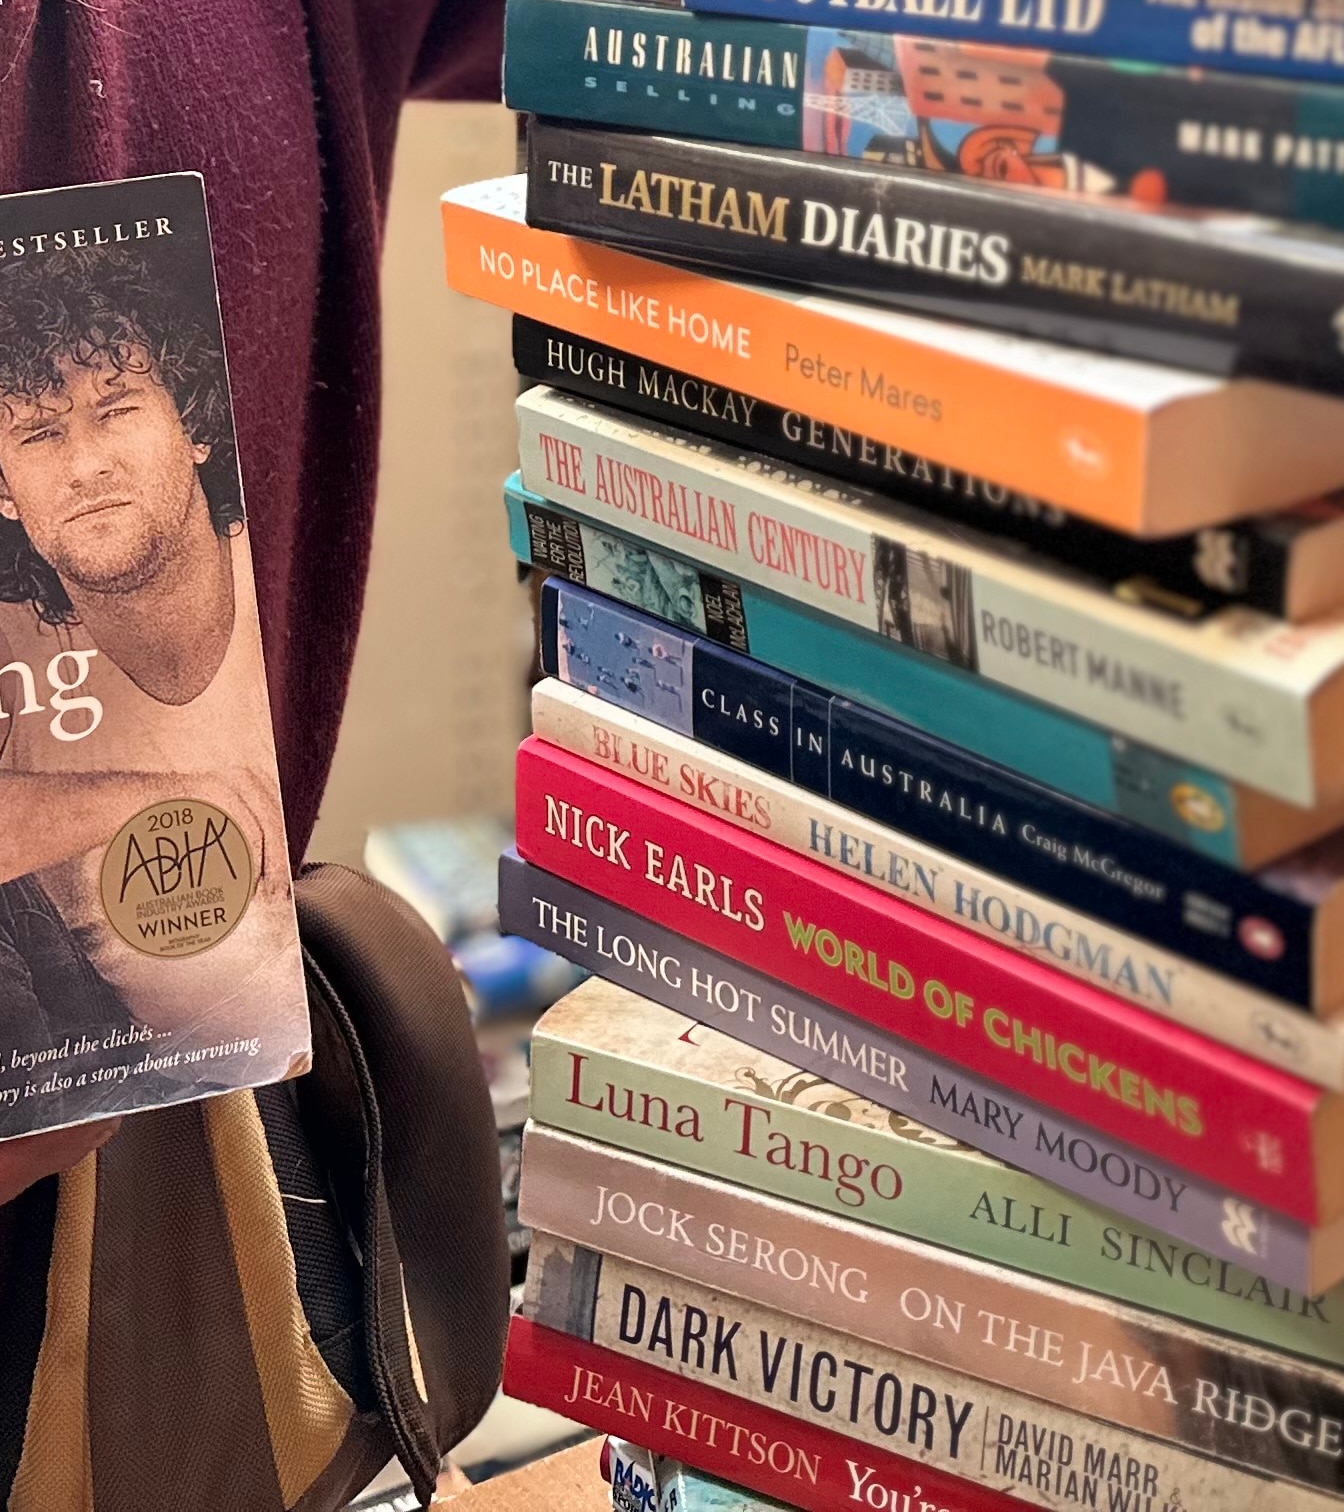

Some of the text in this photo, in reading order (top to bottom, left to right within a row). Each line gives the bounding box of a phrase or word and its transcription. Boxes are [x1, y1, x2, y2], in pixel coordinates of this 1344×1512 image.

[583, 26, 799, 90] AUSTRALIAN
[1190, 12, 1227, 52] of
[1232, 17, 1287, 59] the
[583, 75, 797, 116] SELLING
[1177, 120, 1261, 162] MARK
[548, 160, 1242, 328] THE LATHAM DIARIES MARK LATHAM
[478, 244, 944, 422] NO PLACE LIKE HOME Peter Mares
[546, 337, 627, 391] HUGH
[638, 367, 758, 429] MACKAY
[528, 513, 549, 560] WAITING
[545, 519, 567, 568] FOR THE
[561, 515, 586, 585] REVOLUTION
[538, 432, 1184, 718] THE AUSTRALIAN CENTURY ROBERT MANNE
[705, 593, 726, 624] NOEL
[146, 807, 194, 833] 2018
[701, 687, 1169, 904] CLASS IN AUSTRALIA Craig McGregor
[119, 815, 238, 904] ABIA
[591, 723, 671, 785] BLUE
[679, 762, 773, 831] SKIES
[808, 816, 939, 905] HELEN
[952, 879, 1176, 1010] HODGMAN
[135, 885, 224, 911] AUSTRALIAN BOOK
[135, 895, 225, 920] INDUSTRY AWARDS
[137, 906, 229, 939] WINNER
[544, 793, 1205, 1138] NICK EARLS WORLD OF CHICKENS
[10, 1040, 70, 1074] beyond
[74, 1035, 100, 1055] the
[102, 1023, 155, 1049] clichés
[25, 1080, 38, 1098] is
[41, 1073, 74, 1095] also
[75, 1074, 87, 1088] a
[90, 1061, 133, 1090] story
[133, 1052, 182, 1077] about
[184, 1036, 262, 1070] surviving.
[532, 895, 589, 949] THE
[595, 924, 683, 990] LONG
[690, 968, 762, 1024] HOT
[770, 1003, 911, 1094] SUMMER
[929, 1073, 1024, 1141] MARY
[1034, 1121, 1188, 1214] MOODY
[565, 1051, 705, 1144] Luna
[723, 1098, 904, 1208] Tango
[969, 1189, 1073, 1248] ALLI
[1099, 1225, 1331, 1324] SINCLAIR
[590, 1185, 695, 1249] JOCK
[705, 1223, 869, 1304] SERONG
[899, 1287, 964, 1336] ON
[976, 1308, 1064, 1369] THE
[1071, 1342, 1179, 1406] JAVA
[619, 1282, 975, 1461] DARK VICTORY
[564, 1364, 952, 1512] JEAN KITTSON You'r
[997, 1413, 1074, 1468] DAVID
[1084, 1443, 1161, 1498] MARR
[995, 1443, 1099, 1509] MARIAN
